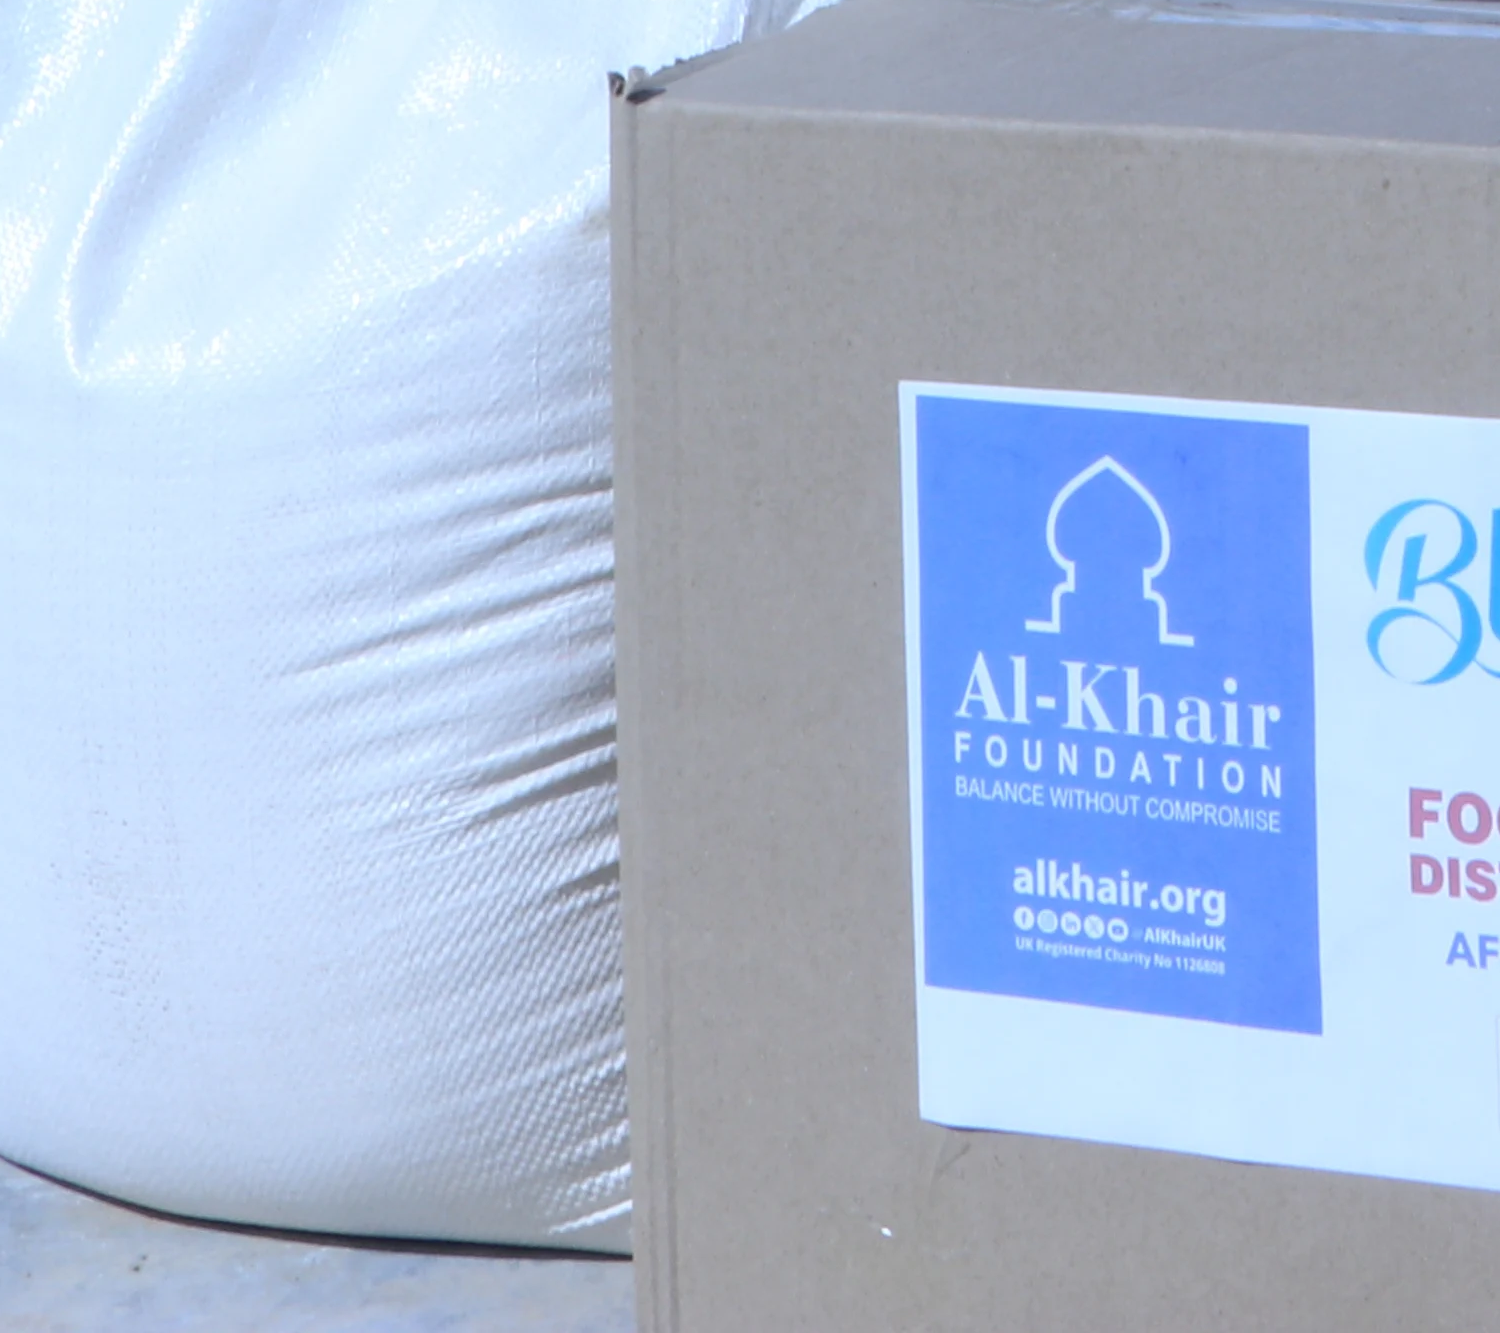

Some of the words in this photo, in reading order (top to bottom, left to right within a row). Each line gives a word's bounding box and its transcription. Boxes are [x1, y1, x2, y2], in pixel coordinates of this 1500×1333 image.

[955, 650, 1281, 751] Al-Khair
[954, 731, 1282, 799] FOUNDATION
[955, 775, 1044, 807] BALANCE
[1050, 786, 1139, 817] WITHOUT
[1145, 797, 1281, 833] COMPROMISE
[1013, 858, 1226, 928] alkhair.org
[1015, 936, 1033, 952] UK
[1036, 937, 1102, 958] Registered
[1105, 947, 1151, 970] Charity
[1153, 952, 1172, 969] No
